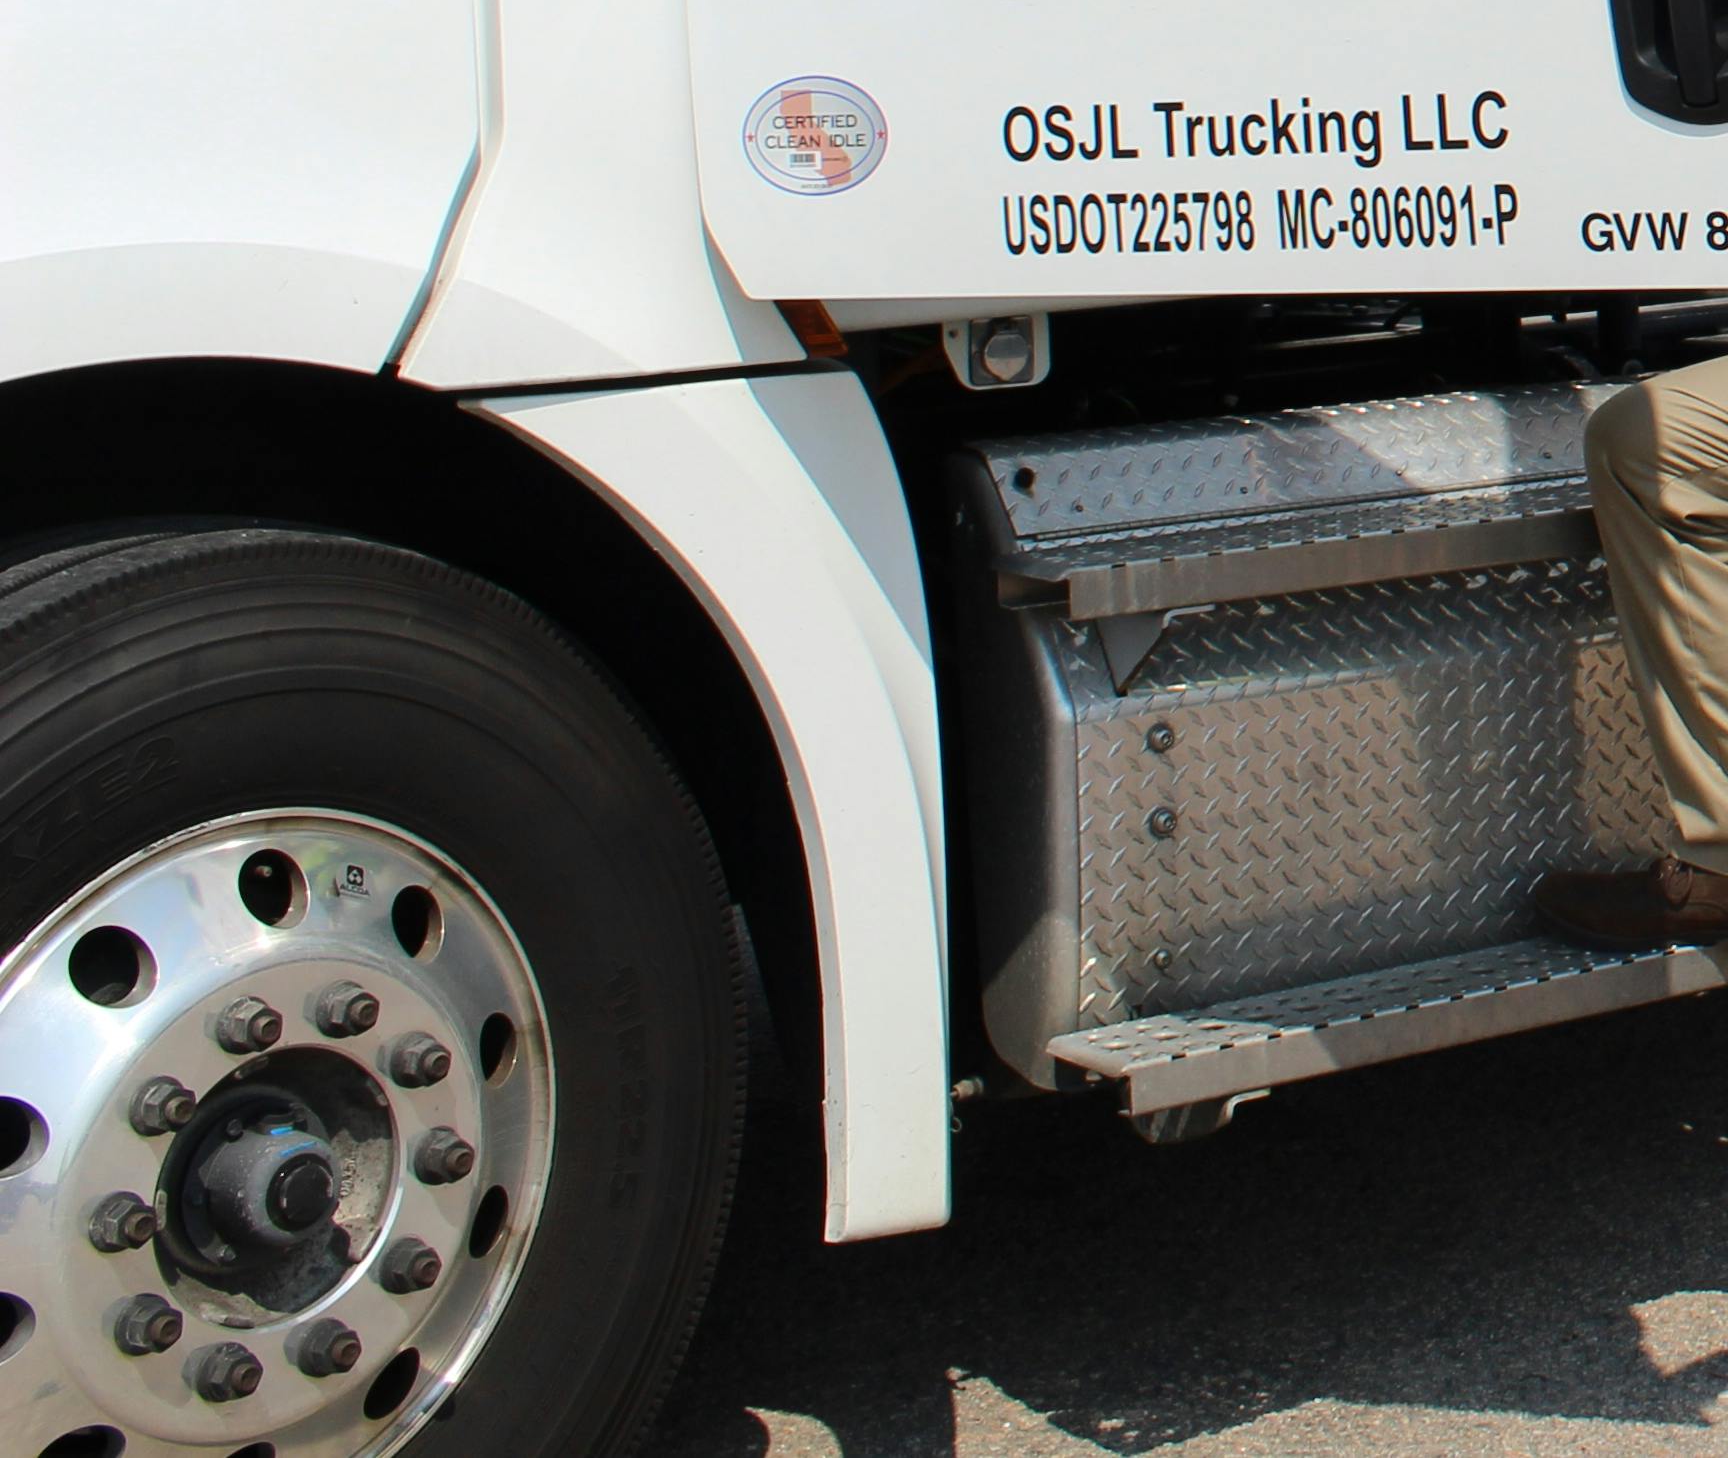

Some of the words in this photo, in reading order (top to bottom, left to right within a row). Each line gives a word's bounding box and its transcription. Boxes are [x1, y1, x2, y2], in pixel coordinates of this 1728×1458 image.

[764, 134, 822, 149] CLEAN
[828, 133, 867, 148] IDLE
[772, 113, 858, 130] CERTIFIED
[1003, 104, 1139, 162] OSJL
[1153, 97, 1382, 169] Trucking
[1402, 90, 1508, 151] LLC
[1003, 190, 1255, 256] USDOT225798
[1277, 184, 1519, 250] MC-806091-P
[1581, 212, 1688, 252] GVW
